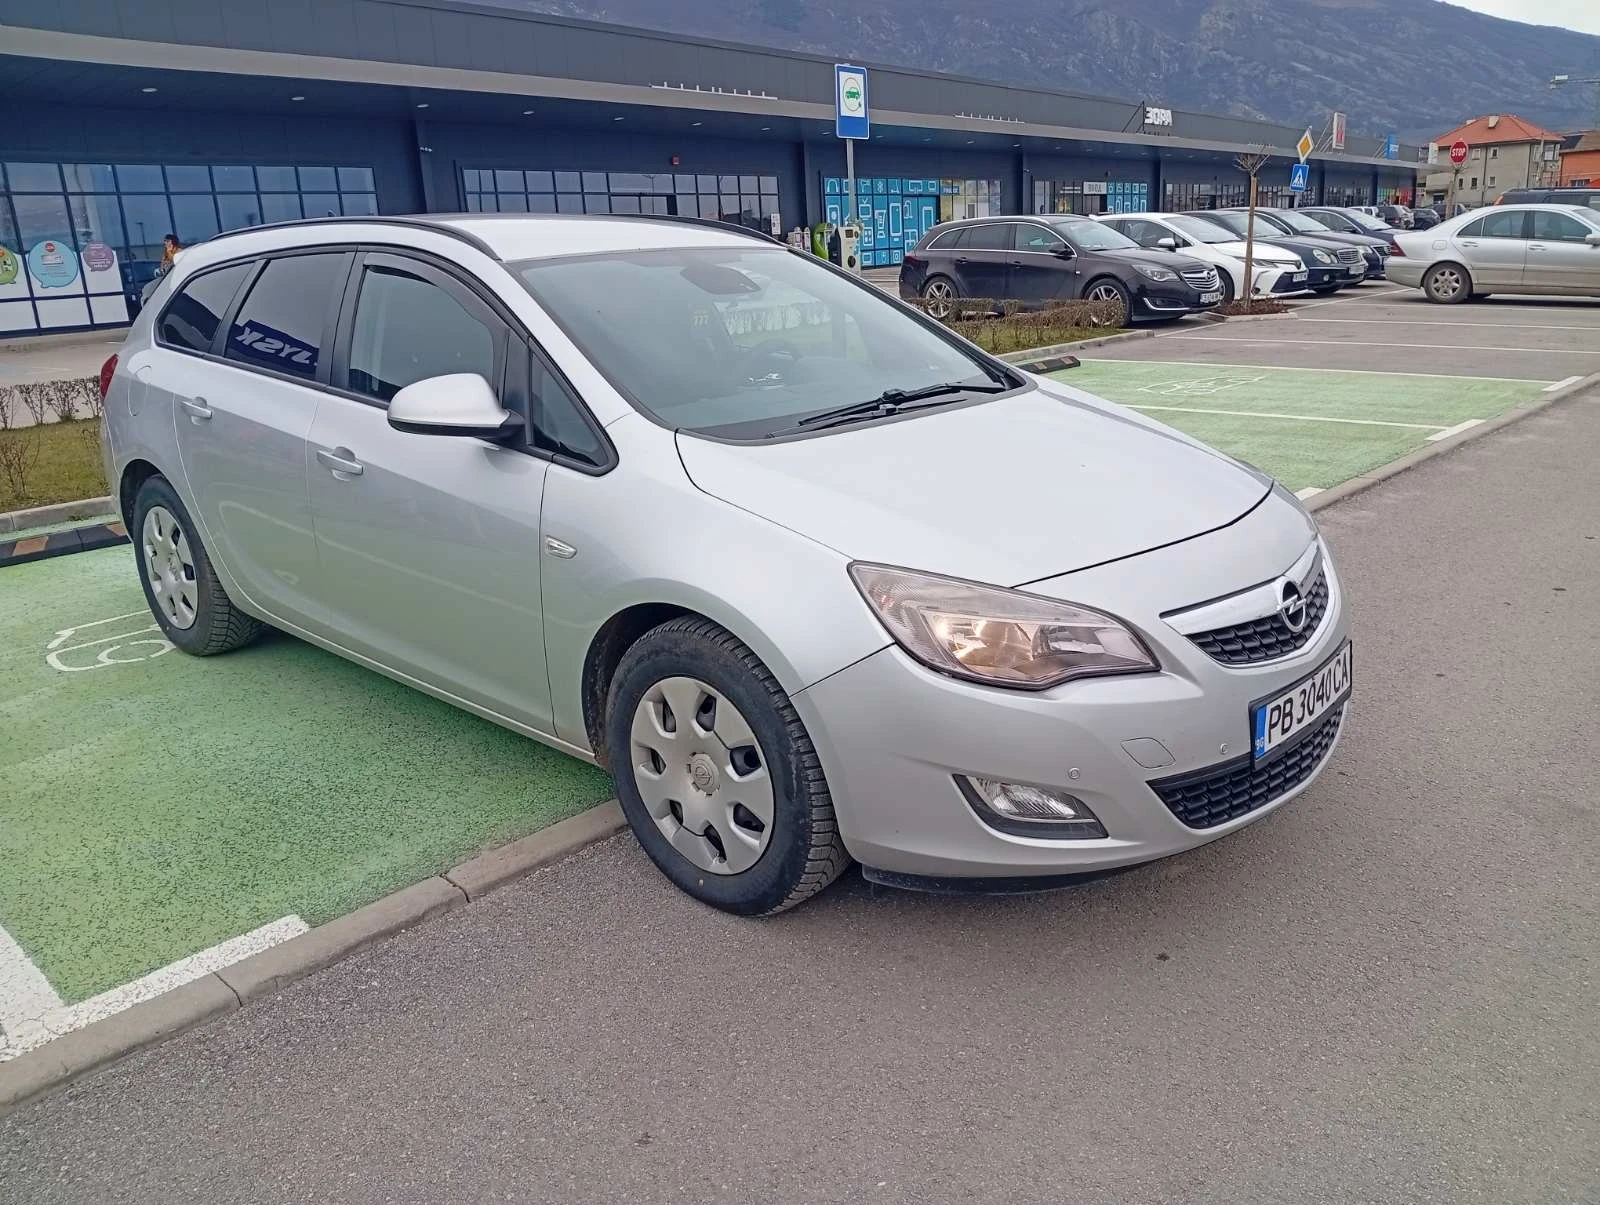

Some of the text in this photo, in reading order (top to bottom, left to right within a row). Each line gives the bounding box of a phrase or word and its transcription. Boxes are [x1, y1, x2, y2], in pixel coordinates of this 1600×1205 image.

[1144, 107, 1172, 126] ЗОРА
[1452, 147, 1465, 157] STOP
[1269, 653, 1348, 744] PB 3040 CA
